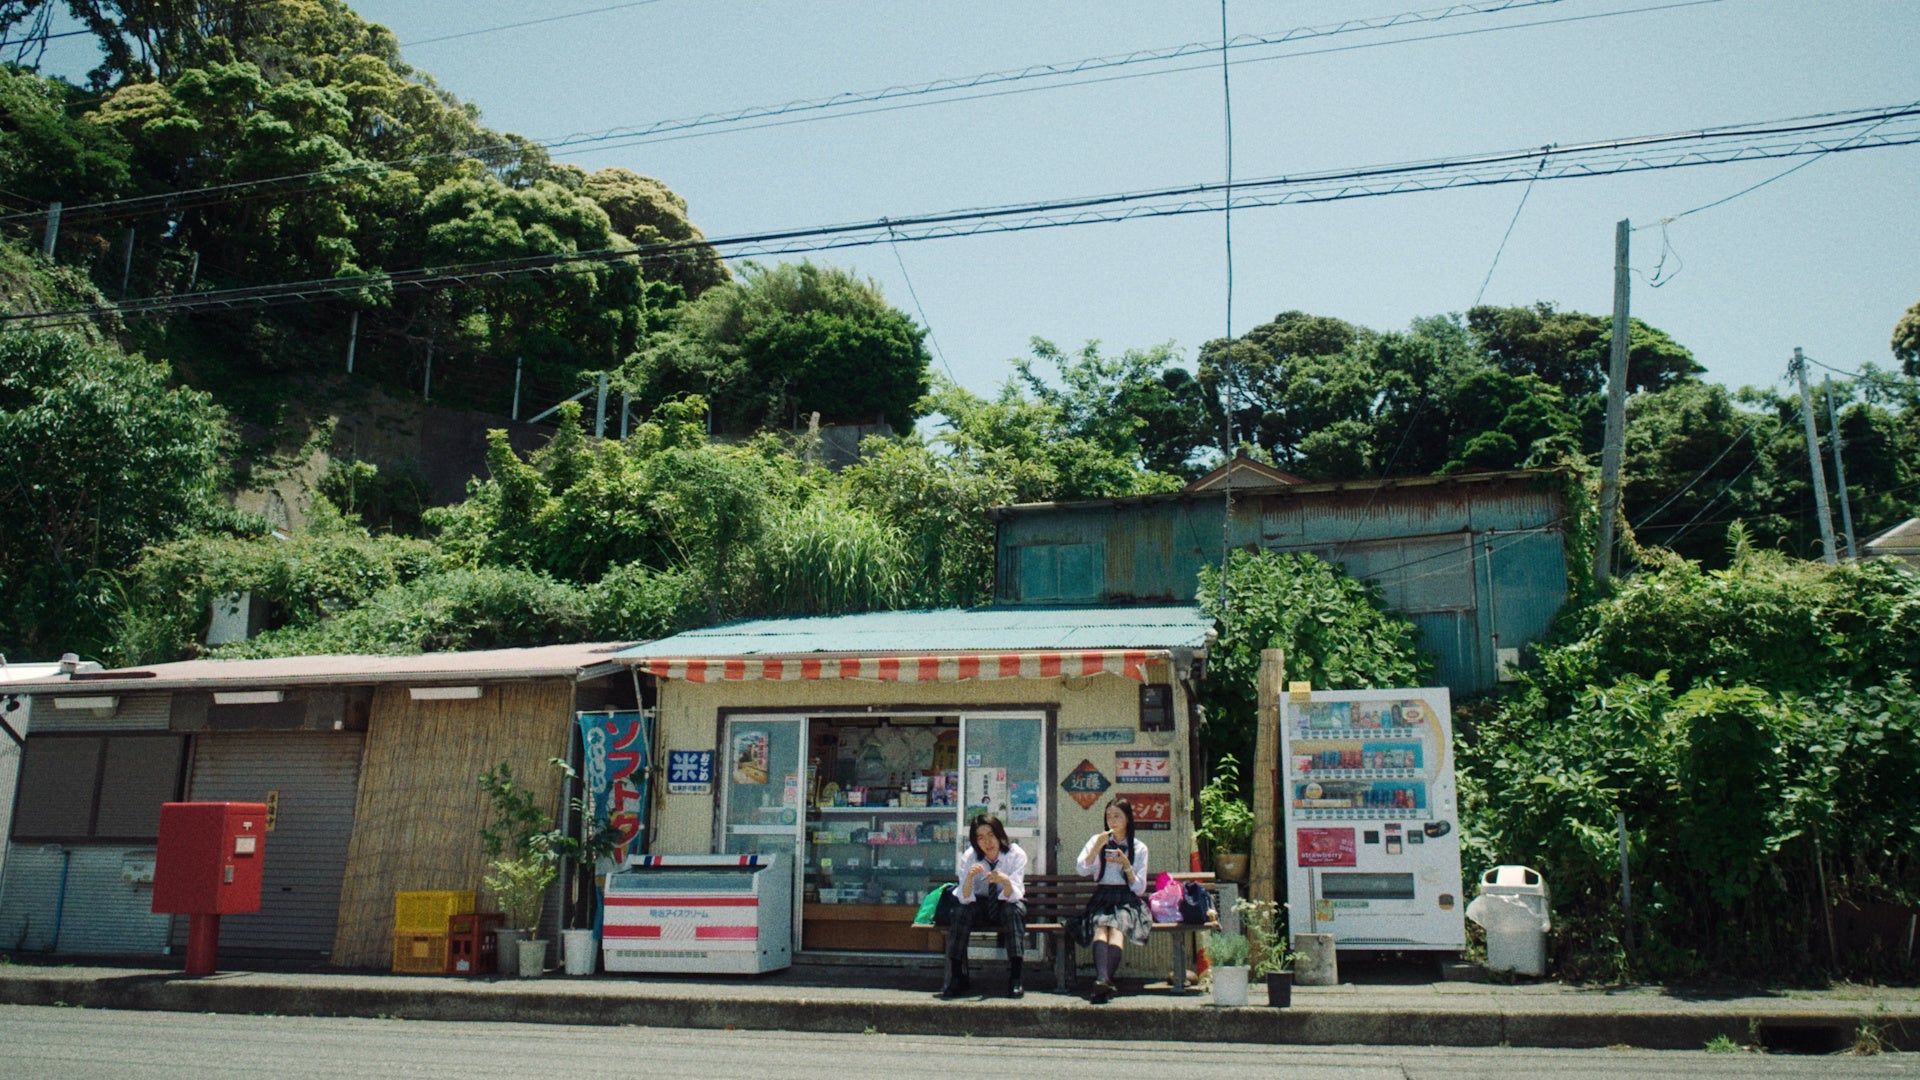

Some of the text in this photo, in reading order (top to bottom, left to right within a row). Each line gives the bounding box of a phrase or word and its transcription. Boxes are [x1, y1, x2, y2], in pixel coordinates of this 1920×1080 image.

[672, 753, 698, 781] 米
[699, 753, 710, 781] おこめ
[1071, 773, 1100, 790] 近藤
[649, 909, 708, 918] 明治アイスクリーム
